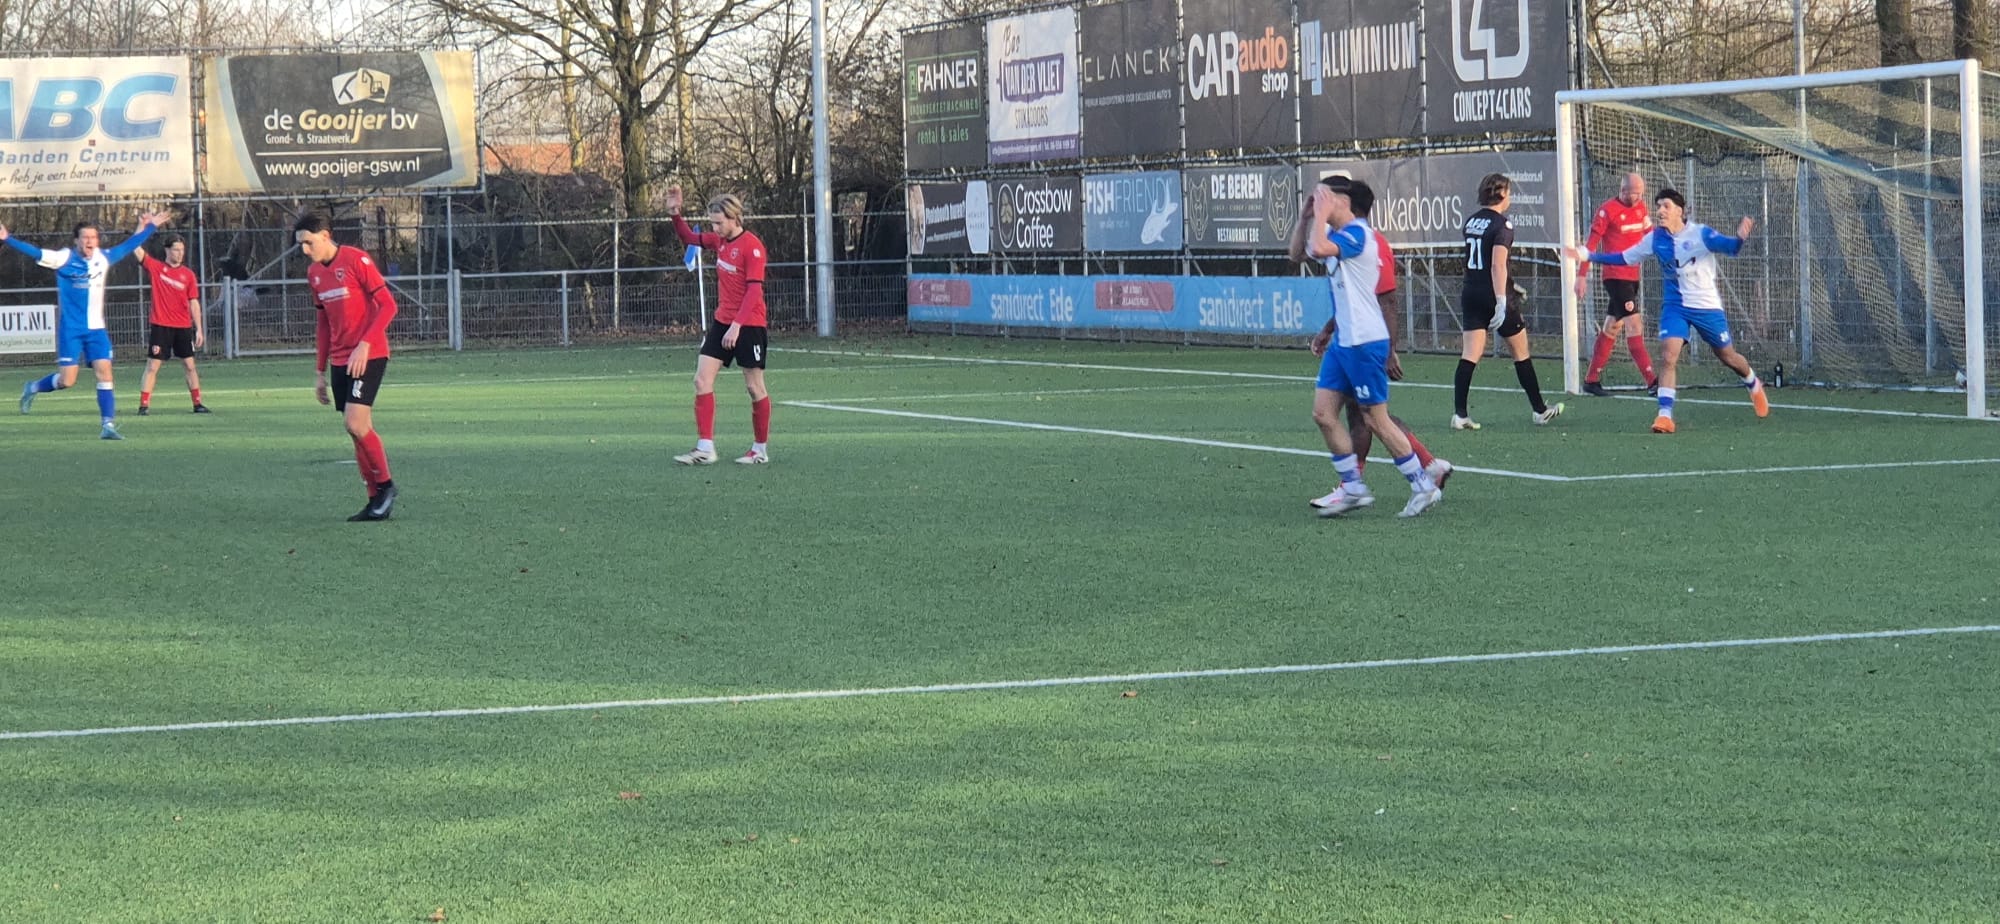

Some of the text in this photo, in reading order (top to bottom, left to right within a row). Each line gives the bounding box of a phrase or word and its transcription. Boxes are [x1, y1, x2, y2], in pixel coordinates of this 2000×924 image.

[1083, 46, 1170, 83] CLANCK
[1239, 25, 1288, 73] audio
[1322, 21, 1417, 78] ALUMINIUM
[917, 58, 978, 93] FAHNER
[1005, 58, 1060, 97] VAN DER VLIET
[1262, 67, 1289, 100] shop
[264, 107, 419, 144] de Gooijer bv
[1015, 105, 1049, 129] STUKADOORS
[265, 133, 351, 145] Grond- & Straatwerk
[918, 122, 969, 145] rental & sales
[79, 148, 170, 165] Centrum
[265, 156, 420, 178] www.gooijer-gsw.nl
[9, 167, 30, 185] heb
[27, 171, 44, 190] je
[47, 172, 66, 182] een
[69, 163, 101, 180] band
[1211, 173, 1263, 200] DE BEREN
[1015, 183, 1073, 214] Crossbow
[1016, 217, 1054, 249] Coffee
[1465, 217, 1492, 230] AFAS
[1466, 237, 1484, 270] 21
[990, 283, 1074, 322] sanidirect Ede
[1199, 287, 1304, 330] sanidirect Ede
